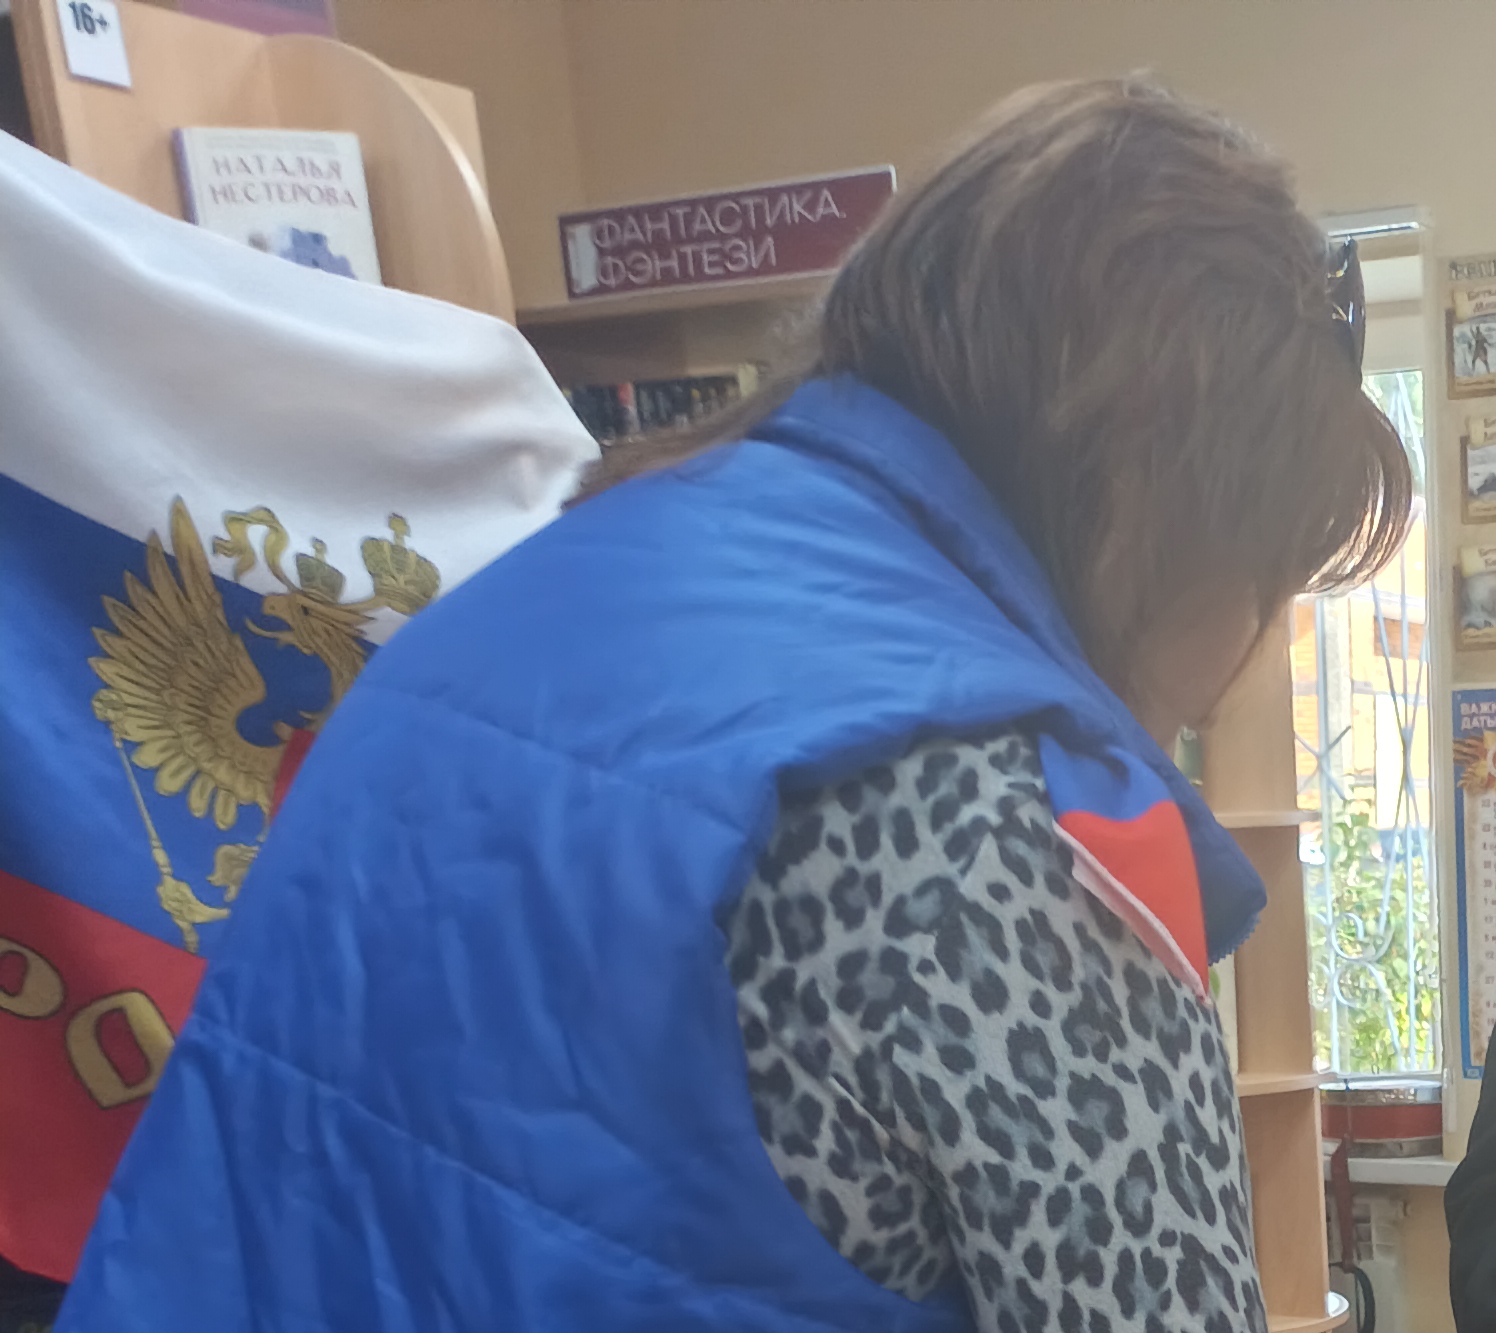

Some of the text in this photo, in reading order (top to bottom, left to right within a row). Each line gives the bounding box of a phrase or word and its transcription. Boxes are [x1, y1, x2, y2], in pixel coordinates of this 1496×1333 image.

[68, 1, 109, 35] 16+
[211, 155, 344, 181] НАТАЛЬЯ
[208, 183, 359, 209] НЕСТЕРОВА
[598, 234, 777, 288] ФЭНТЕЗИ
